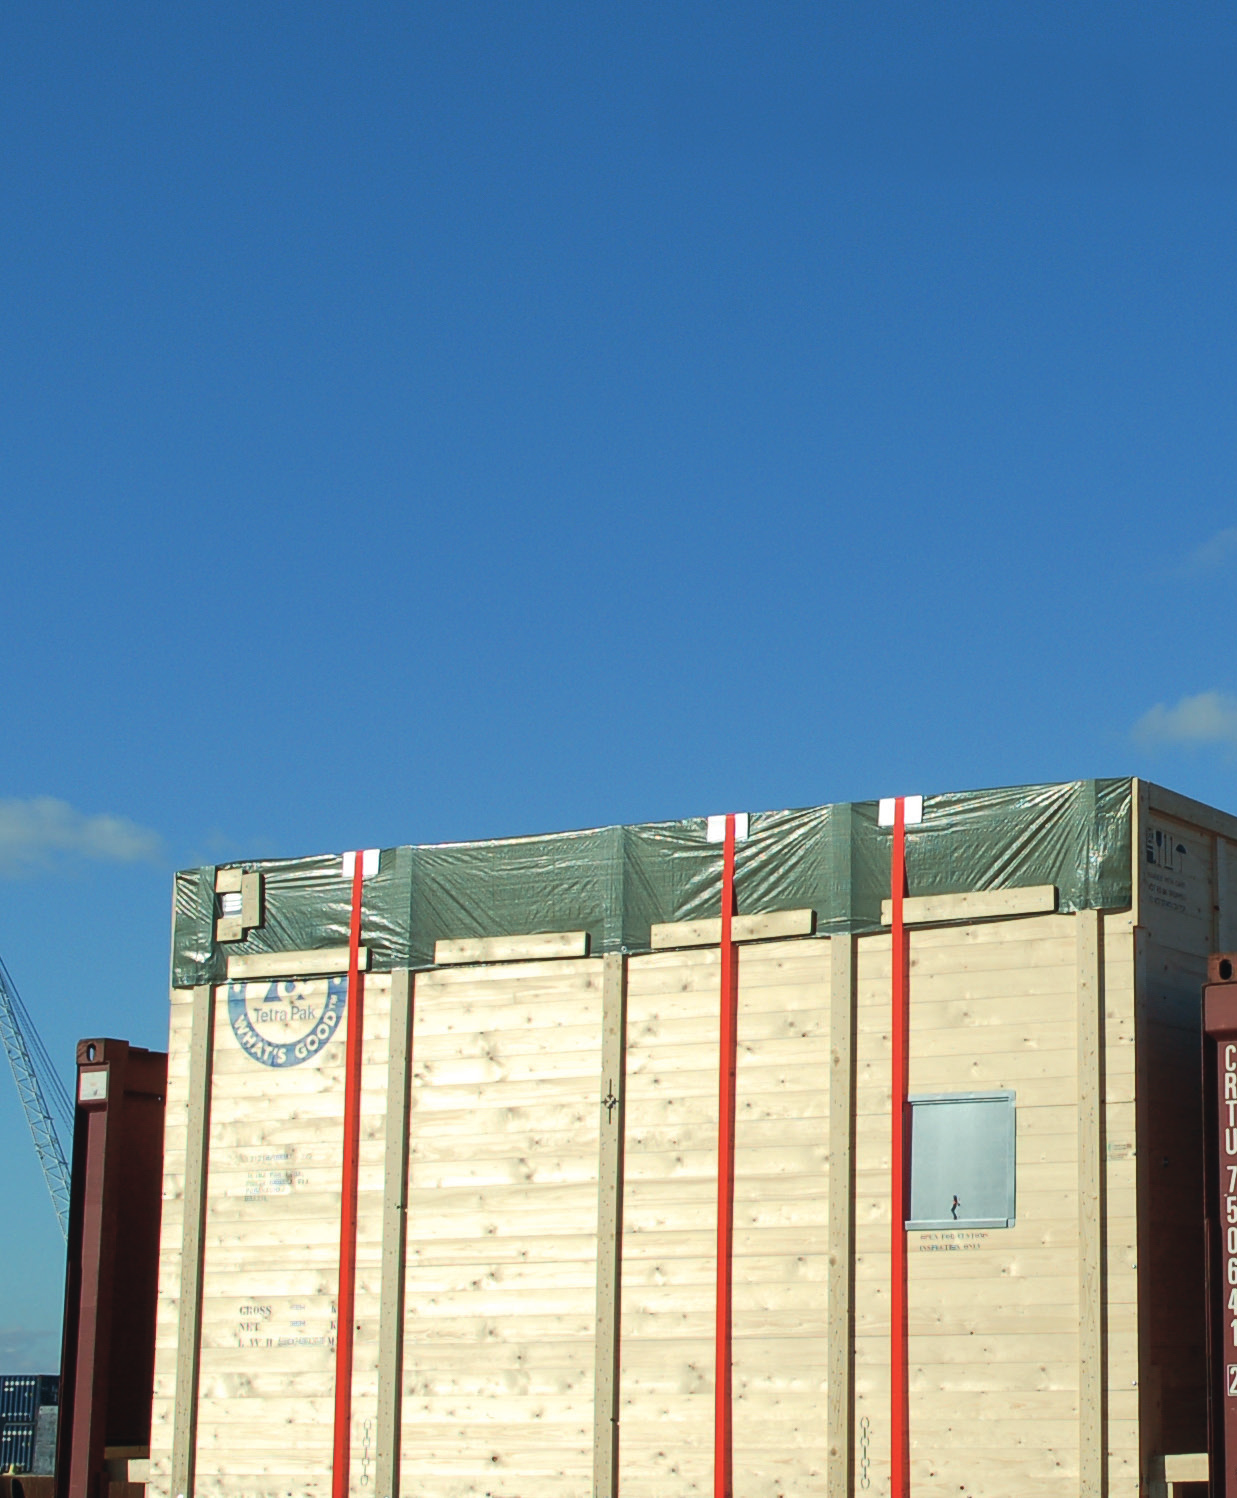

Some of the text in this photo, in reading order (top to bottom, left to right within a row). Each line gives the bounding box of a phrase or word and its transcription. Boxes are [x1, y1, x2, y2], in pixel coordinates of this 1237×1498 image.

[253, 1005, 315, 1023] Tetra Pak
[234, 1014, 287, 1064] WHAT'S
[1225, 1044, 1237, 1155] CRTU
[239, 1304, 272, 1316] GROSS
[239, 1321, 259, 1332] NET
